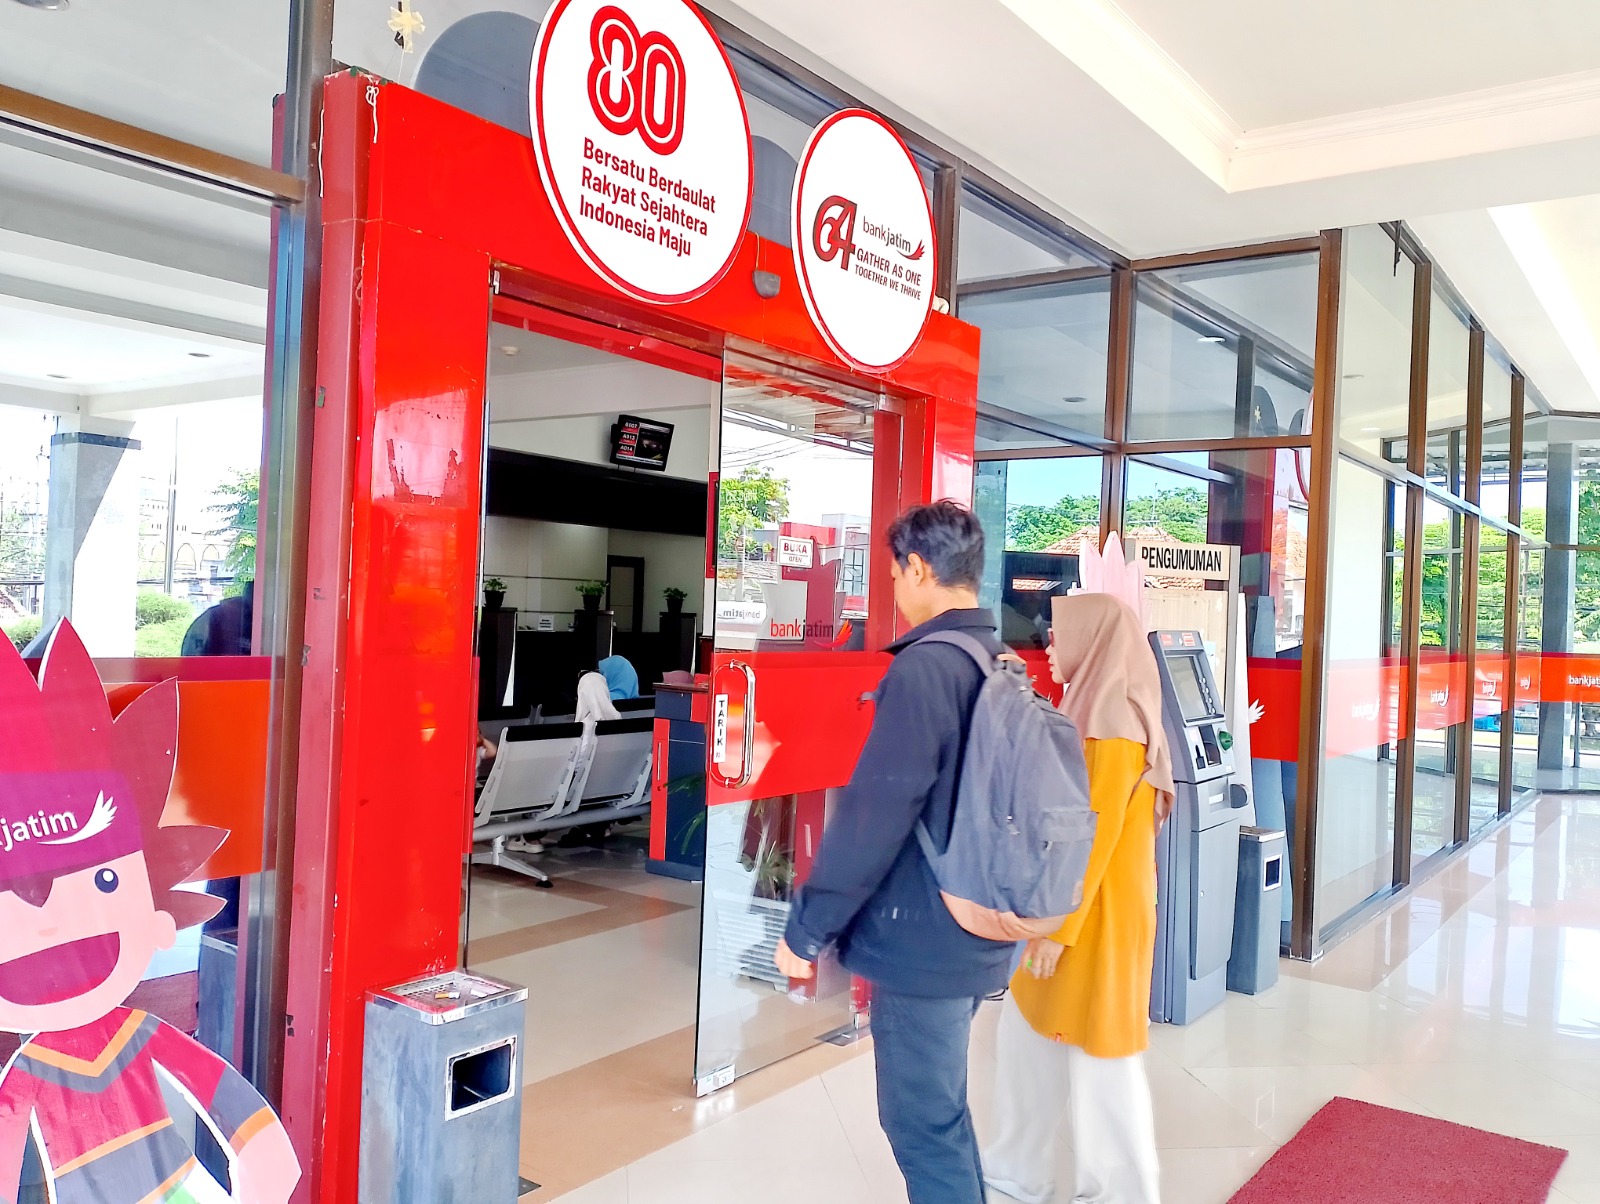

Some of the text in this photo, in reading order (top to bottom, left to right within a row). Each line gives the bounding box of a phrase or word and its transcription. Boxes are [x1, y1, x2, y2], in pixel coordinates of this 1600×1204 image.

[587, 5, 686, 155] 80
[583, 136, 716, 214] Bersatu Berdaulat
[581, 165, 709, 236] Rakyat Sejahtera
[580, 194, 692, 257] Indonesia Maju
[812, 195, 858, 272] 64
[863, 216, 912, 253] bankjatim
[855, 264, 921, 301] TOGETHER WE THRIVE
[857, 248, 922, 287] GATHER AS ONE
[783, 542, 808, 554] BUKA
[1141, 546, 1222, 571] PENGUMUMAN
[770, 618, 834, 641] bankjatim
[717, 699, 725, 746] TARIK
[0, 810, 78, 852] jatim
